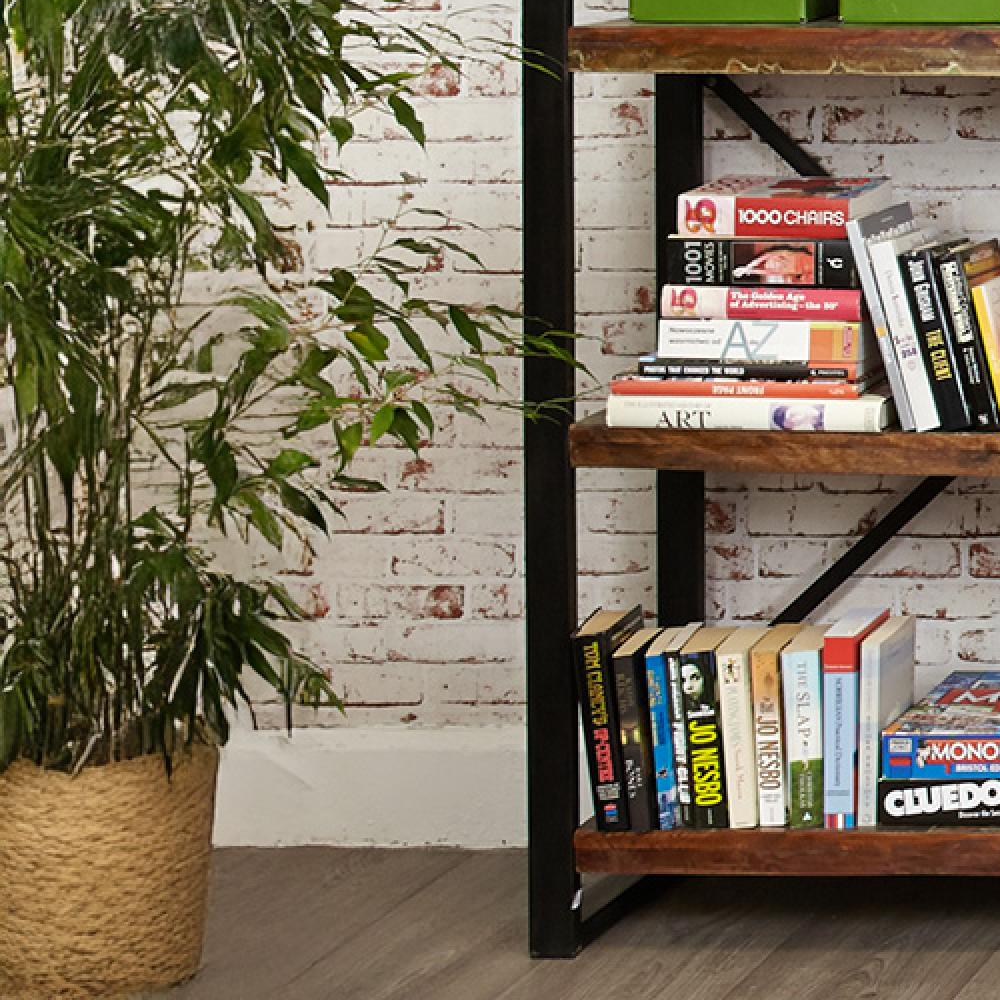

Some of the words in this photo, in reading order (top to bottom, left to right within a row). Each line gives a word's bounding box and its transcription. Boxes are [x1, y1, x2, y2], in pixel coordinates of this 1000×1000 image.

[738, 209, 782, 225] 1000
[783, 209, 845, 227] CHAIRS
[684, 241, 703, 283] 1001
[730, 291, 747, 300] The
[656, 410, 711, 429] ART
[757, 715, 779, 737] JO
[795, 691, 812, 739] SLAP
[689, 719, 717, 745] JO
[691, 747, 723, 807] NESBO
[757, 739, 781, 790] NESBO
